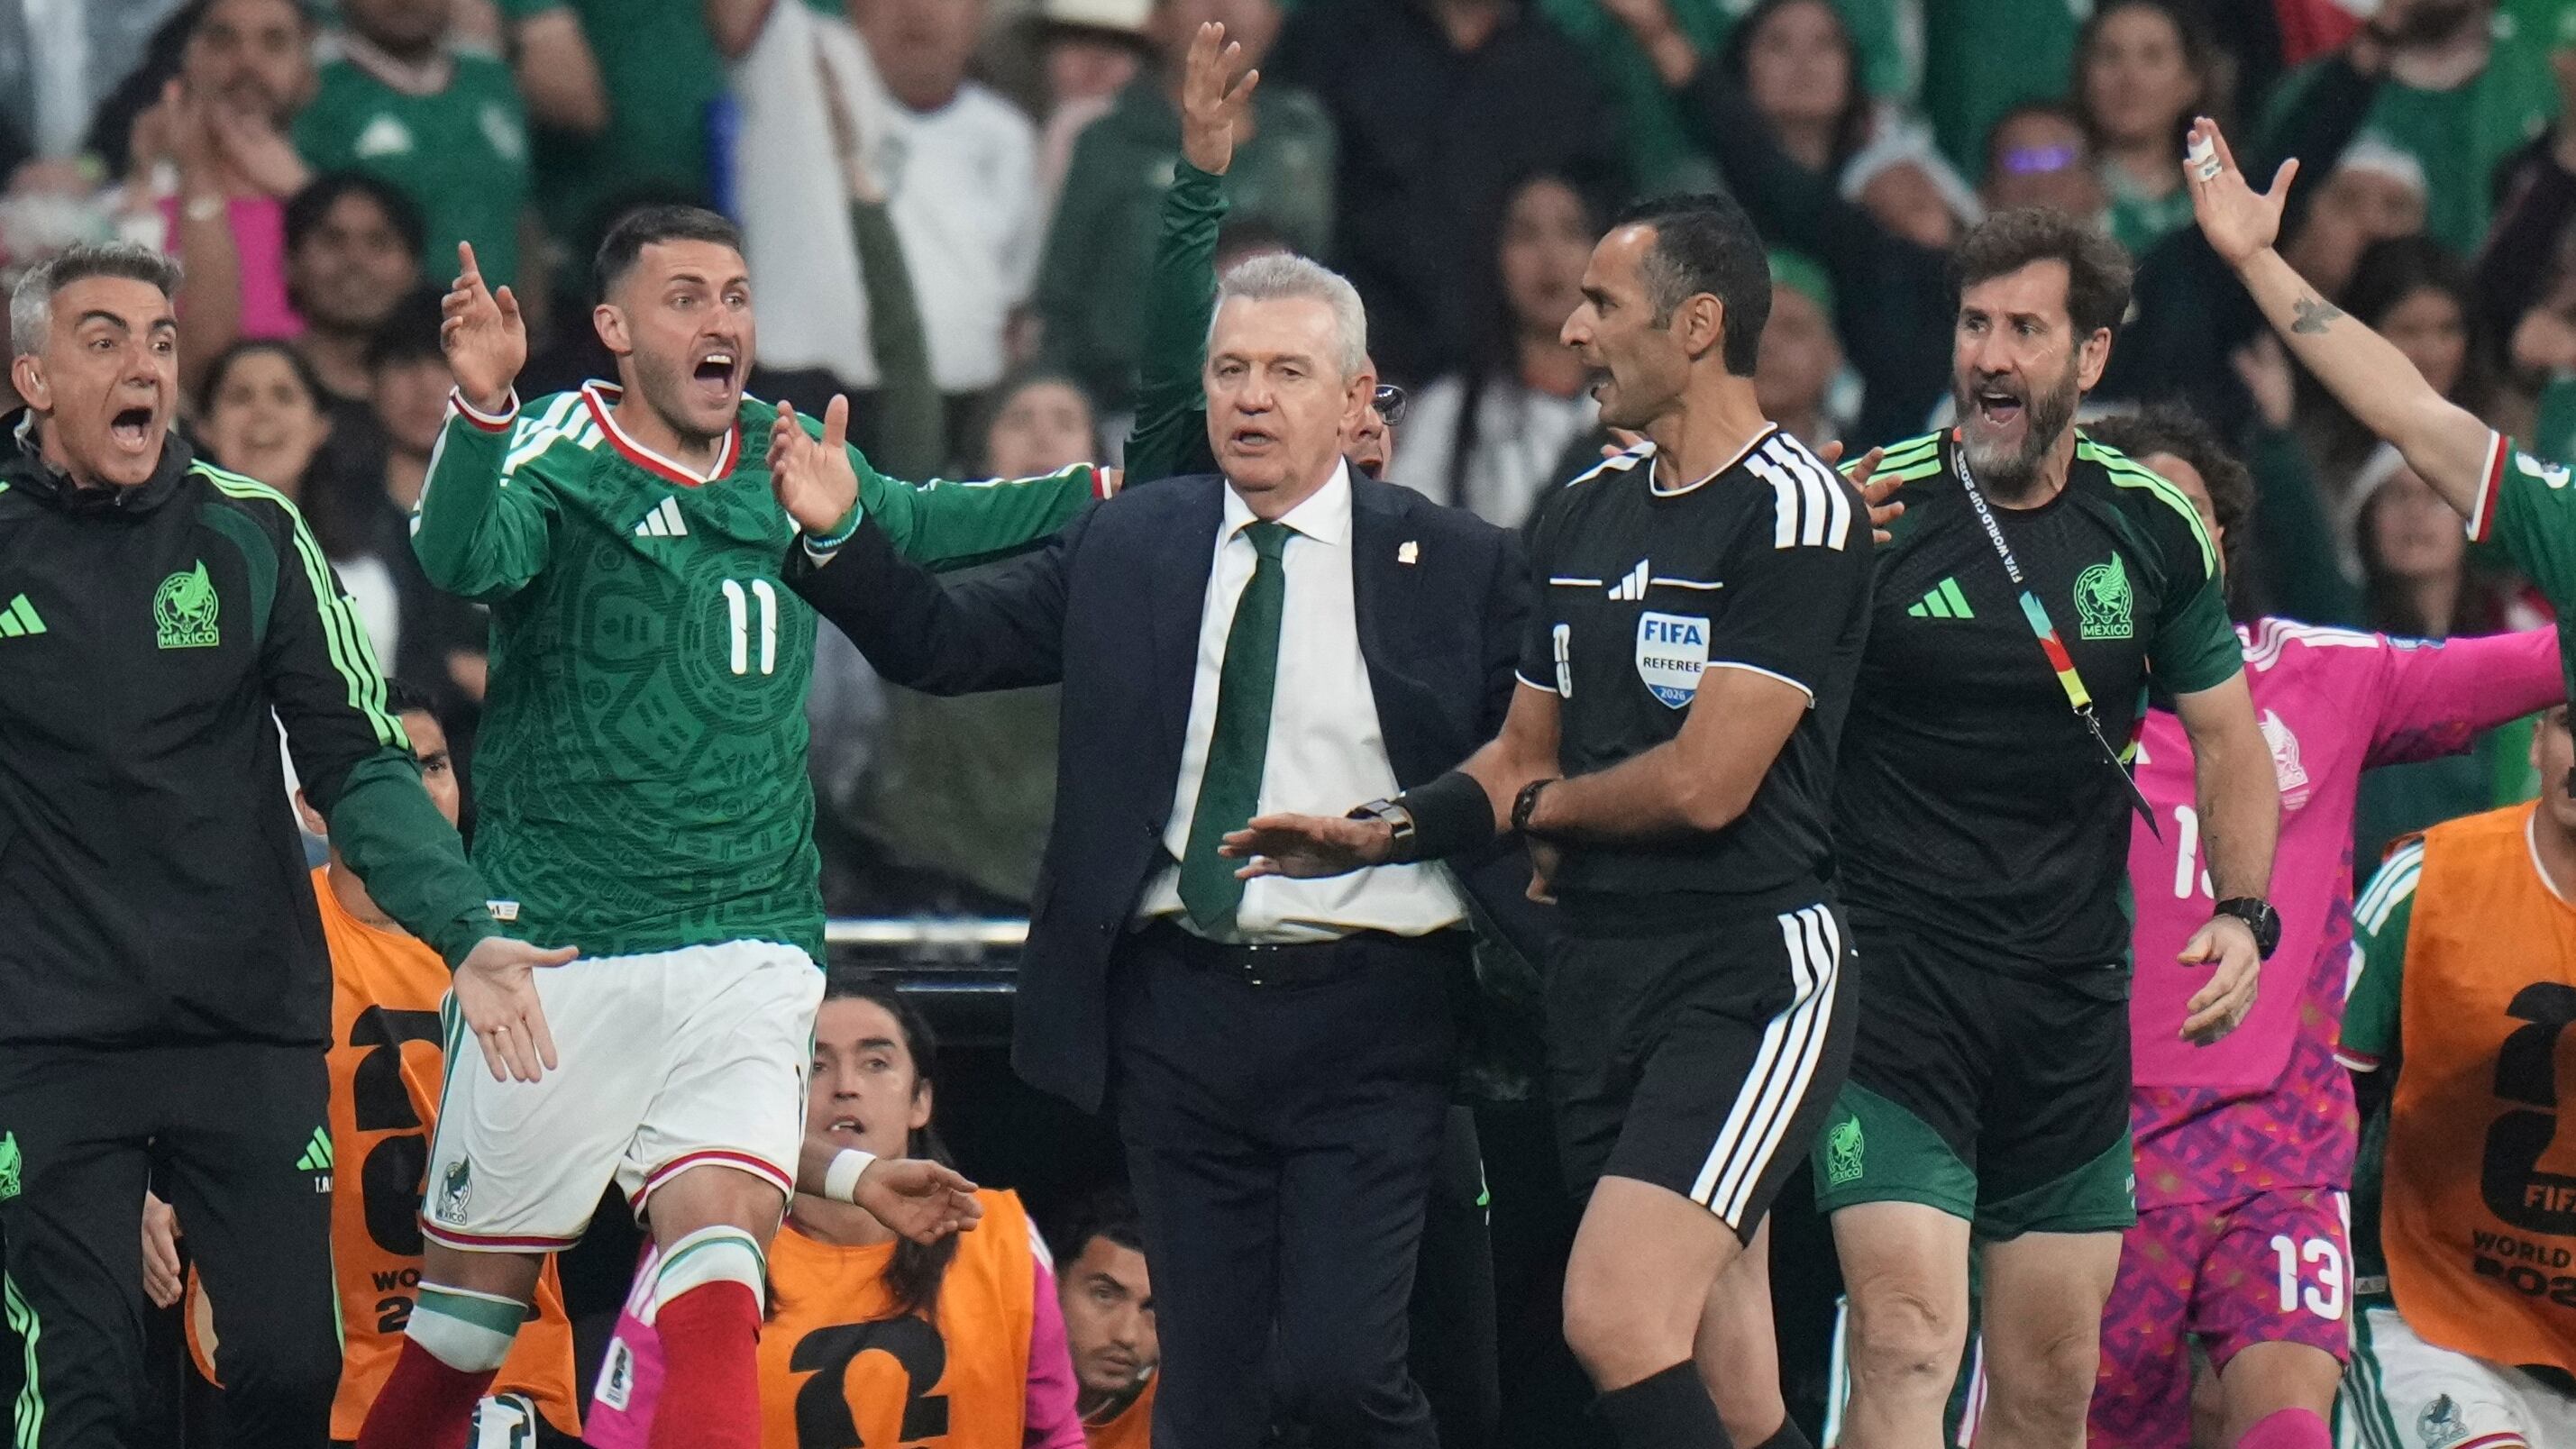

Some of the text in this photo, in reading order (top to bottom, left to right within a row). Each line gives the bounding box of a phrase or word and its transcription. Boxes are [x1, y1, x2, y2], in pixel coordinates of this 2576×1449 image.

[1957, 451, 2023, 583] FIFA WORLD CUP 2026
[722, 579, 776, 675] 11
[1645, 620, 1703, 646] FIFA
[2083, 622, 2131, 636] MÉXICO
[1643, 657, 1703, 673] REFEREE
[1660, 688, 1686, 701] 2026
[2174, 805, 2215, 899] 1
[2472, 1228, 2571, 1269] WORLD
[2270, 1235, 2343, 1321] 13
